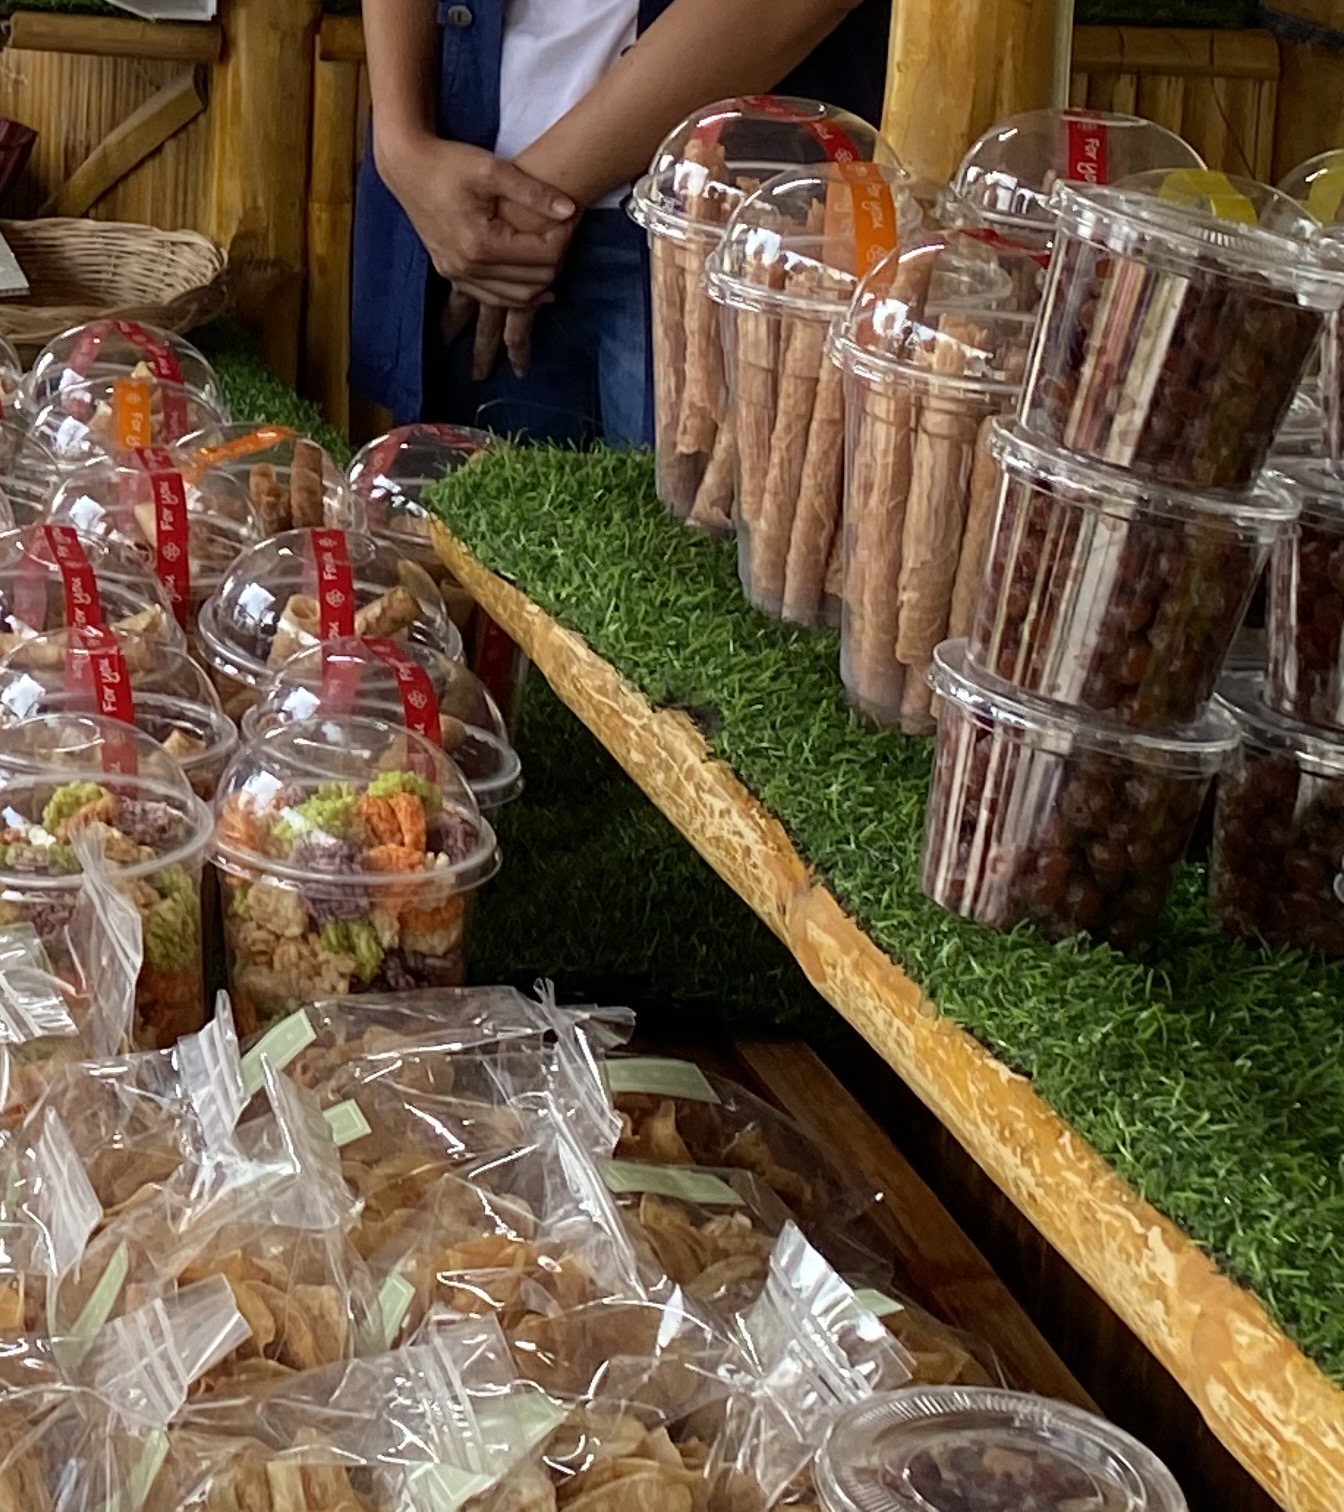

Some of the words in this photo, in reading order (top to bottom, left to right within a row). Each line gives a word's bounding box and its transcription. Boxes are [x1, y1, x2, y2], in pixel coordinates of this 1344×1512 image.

[1084, 137, 1100, 161] For
[160, 481, 179, 505] you
[160, 508, 175, 531] For
[71, 576, 92, 605] you
[98, 657, 121, 683] you
[101, 684, 118, 713] For
